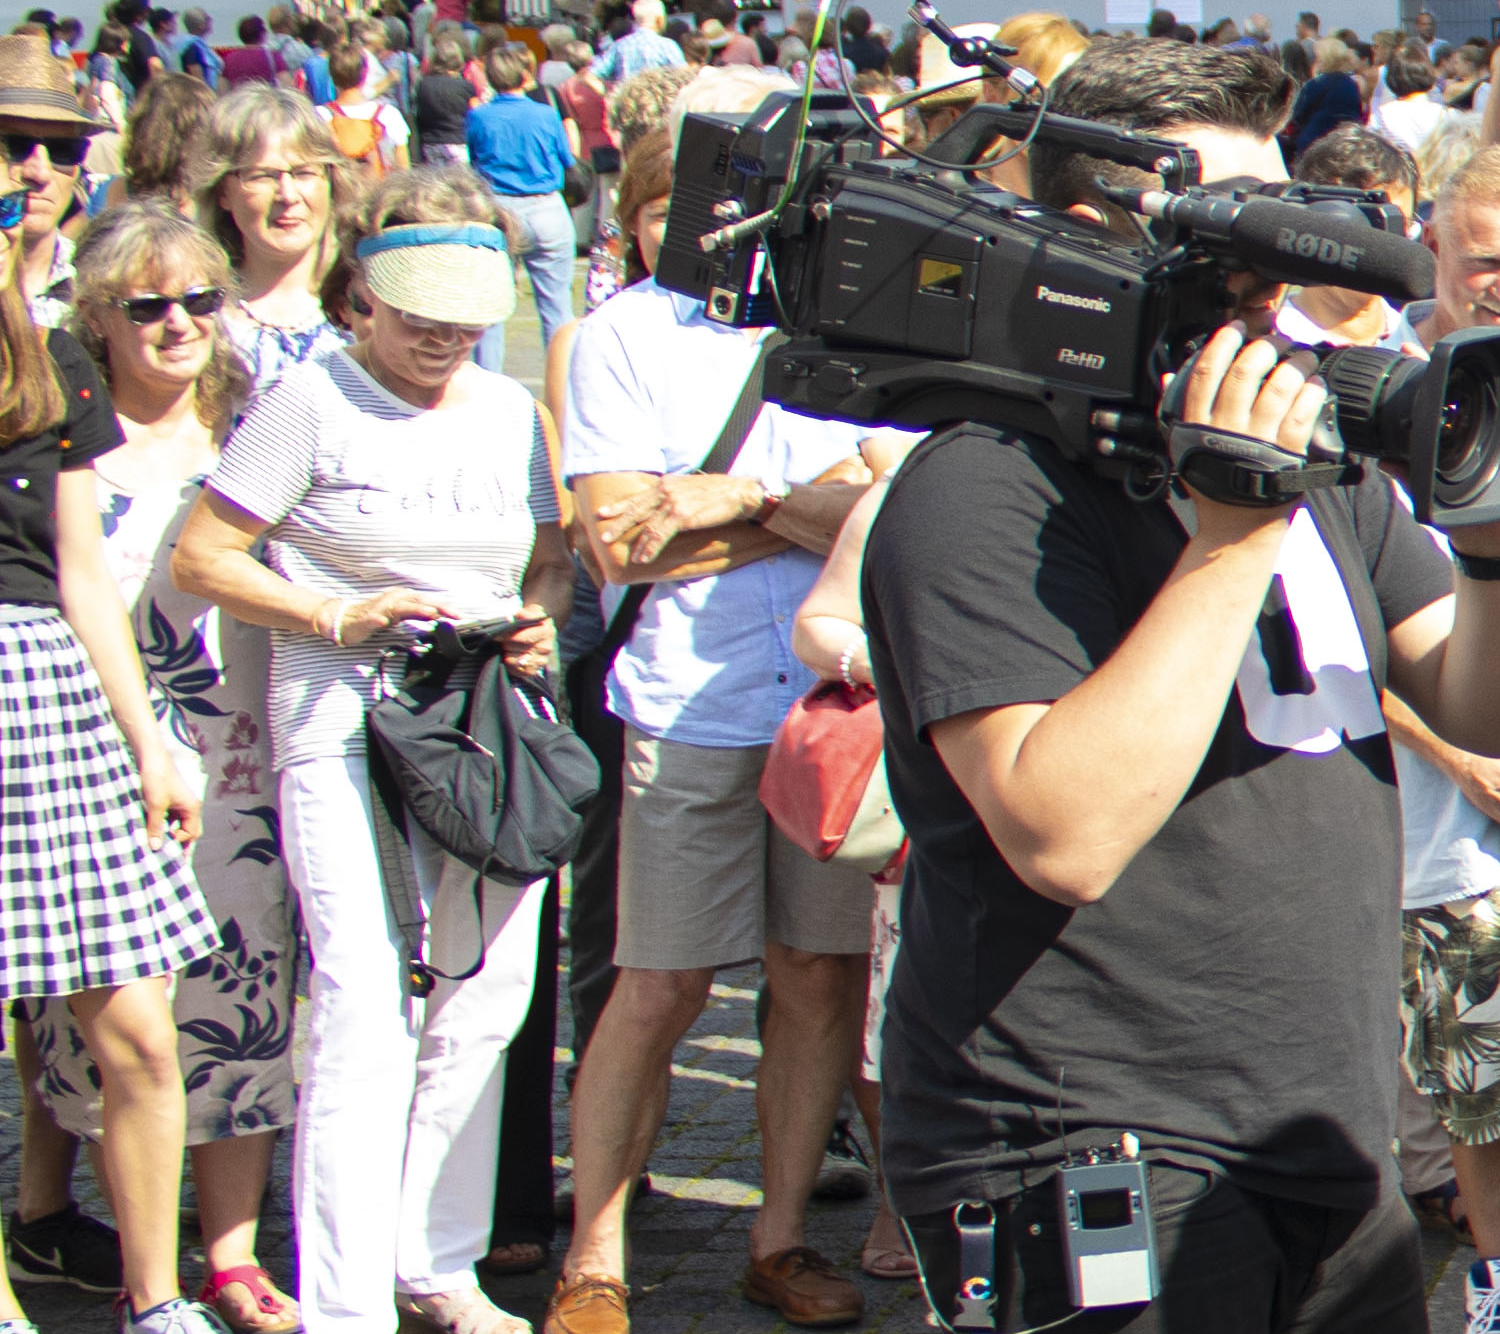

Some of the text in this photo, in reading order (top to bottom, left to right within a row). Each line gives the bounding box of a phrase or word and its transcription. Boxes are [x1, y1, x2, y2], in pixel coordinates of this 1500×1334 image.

[1276, 226, 1361, 269] RØDE
[1036, 284, 1112, 314] Panasonic
[1202, 434, 1259, 458] Canon
